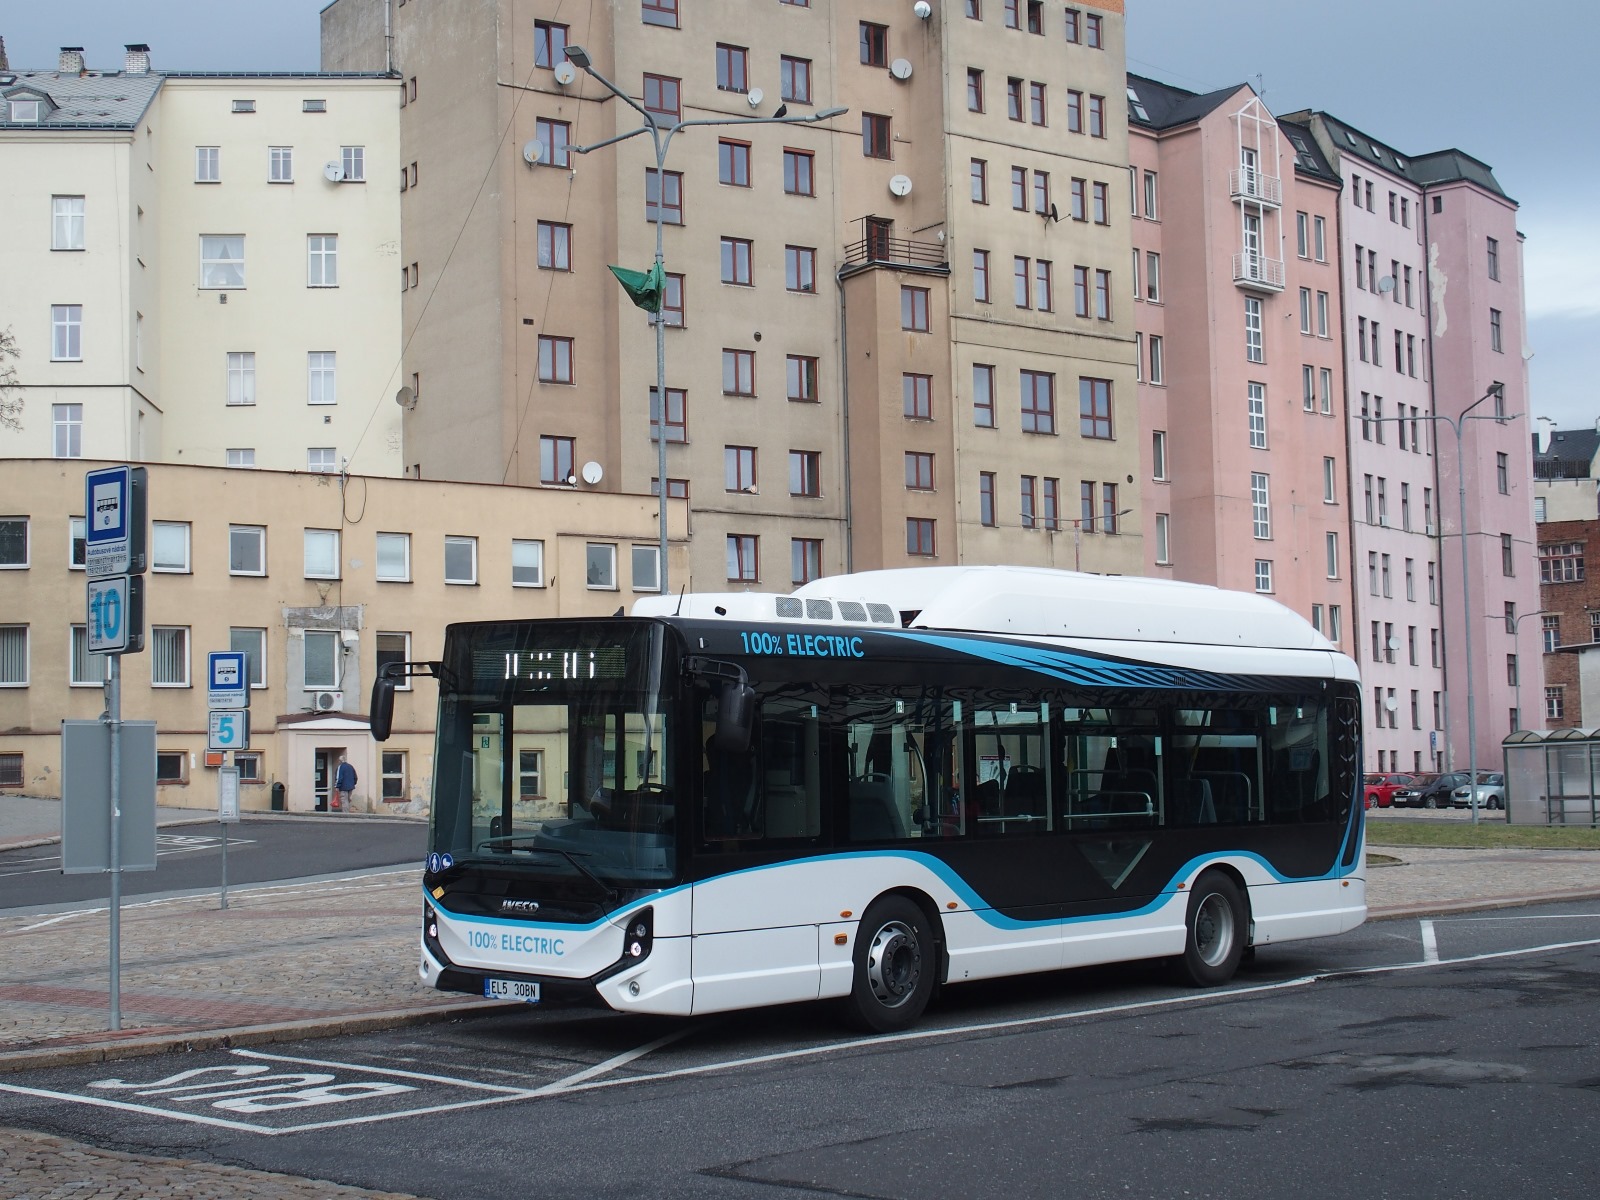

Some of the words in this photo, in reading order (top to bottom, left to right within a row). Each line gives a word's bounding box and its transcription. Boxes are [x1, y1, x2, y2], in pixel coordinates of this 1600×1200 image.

[91, 588, 121, 640] 10
[741, 632, 783, 655] 100%
[787, 634, 865, 658] ELECTRIC
[218, 717, 234, 744] 5
[501, 899, 540, 912] IVECO
[468, 931, 498, 950] 100%
[501, 934, 565, 956] ELECTRIC
[491, 981, 508, 995] EL5
[514, 983, 536, 998] 30BN
[88, 1064, 421, 1114] BUS
